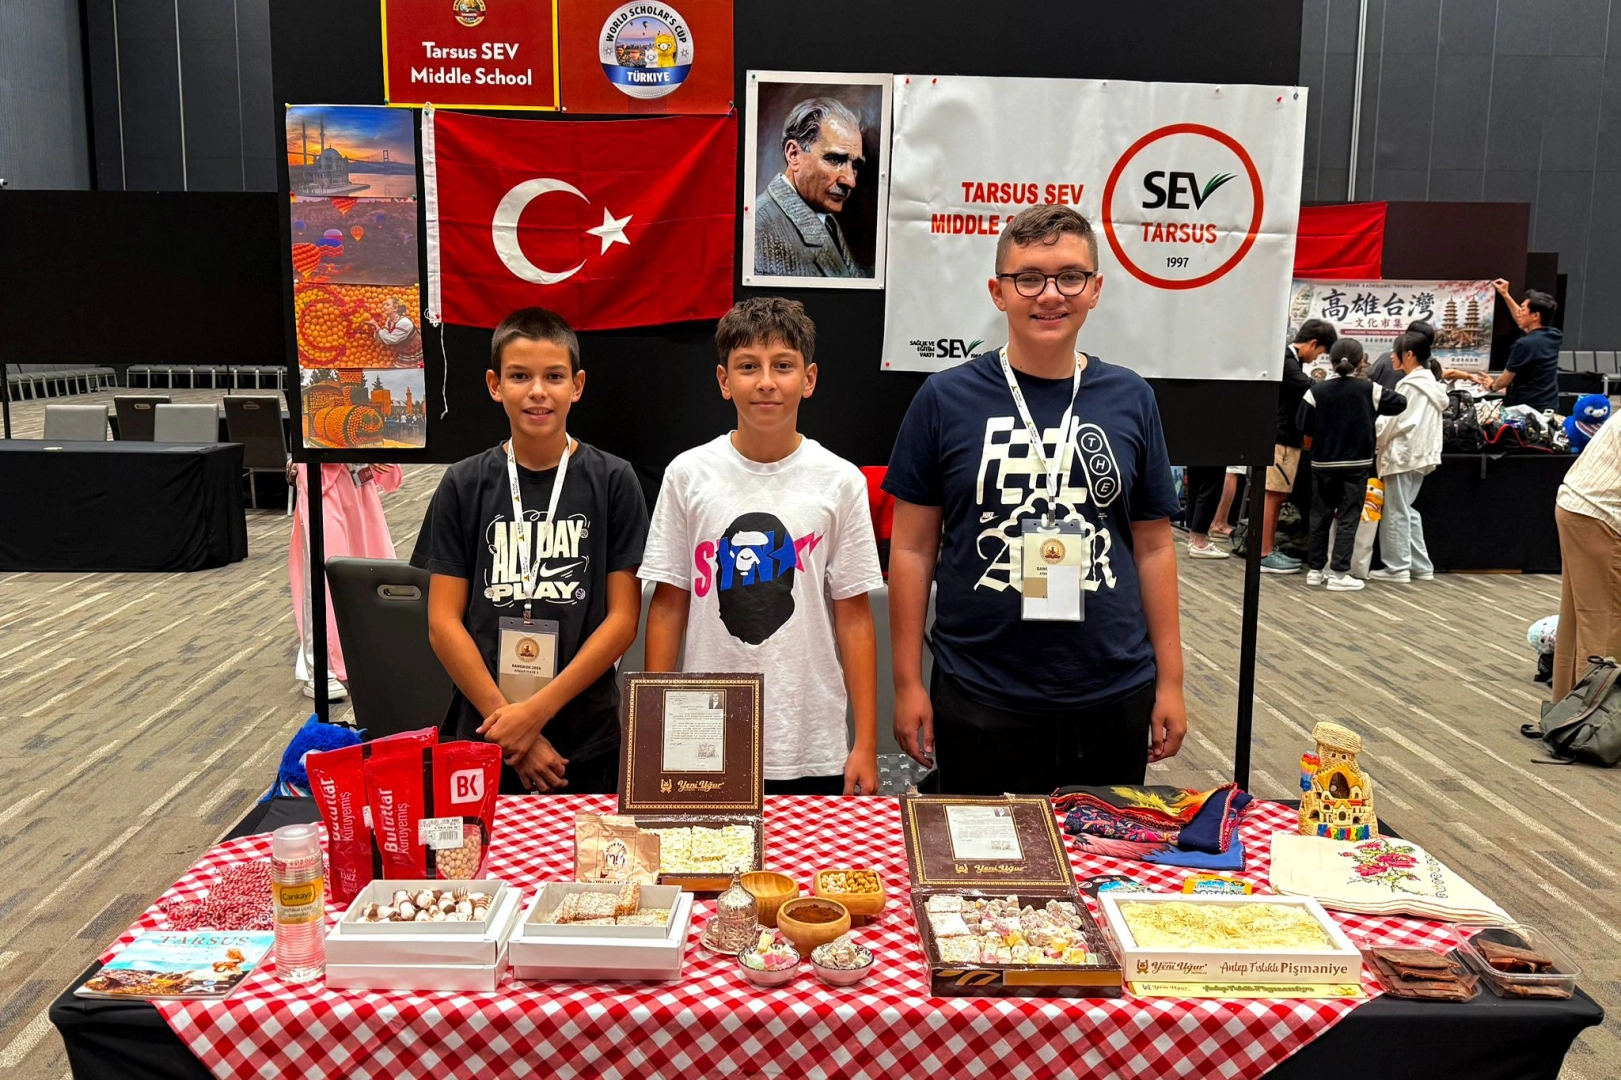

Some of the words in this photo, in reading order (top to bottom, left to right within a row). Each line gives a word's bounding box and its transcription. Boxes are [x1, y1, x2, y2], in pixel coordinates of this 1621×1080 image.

[606, 13, 628, 42] WORLD
[629, 5, 677, 26] SCHOLAR'S
[674, 25, 687, 43] CUP
[422, 42, 477, 60] Tarsus
[481, 42, 520, 60] SEV
[411, 67, 472, 85] Middle
[475, 68, 532, 86] School
[962, 181, 1039, 204] TARSUS
[1044, 184, 1084, 205] SEV
[1142, 170, 1238, 211] SEV
[931, 213, 999, 235] MIDDLE
[1142, 222, 1217, 244] TARSUS
[1166, 256, 1189, 268] 1997
[1321, 288, 1435, 321] 高雄台灣
[936, 338, 984, 359] SEV
[537, 519, 584, 559] DAY
[491, 581, 581, 602] PLAY
[677, 779, 698, 793] Yeni
[340, 791, 356, 842] Kuruyemiş
[379, 787, 398, 853] Bulutlar
[397, 802, 412, 854] Kuruyemiş
[159, 935, 250, 946] TARSUS
[1151, 961, 1176, 974] Yeni
[1176, 961, 1205, 974] Uğur
[1220, 961, 1249, 976] Antep
[1280, 962, 1348, 976] Pişmaniye
